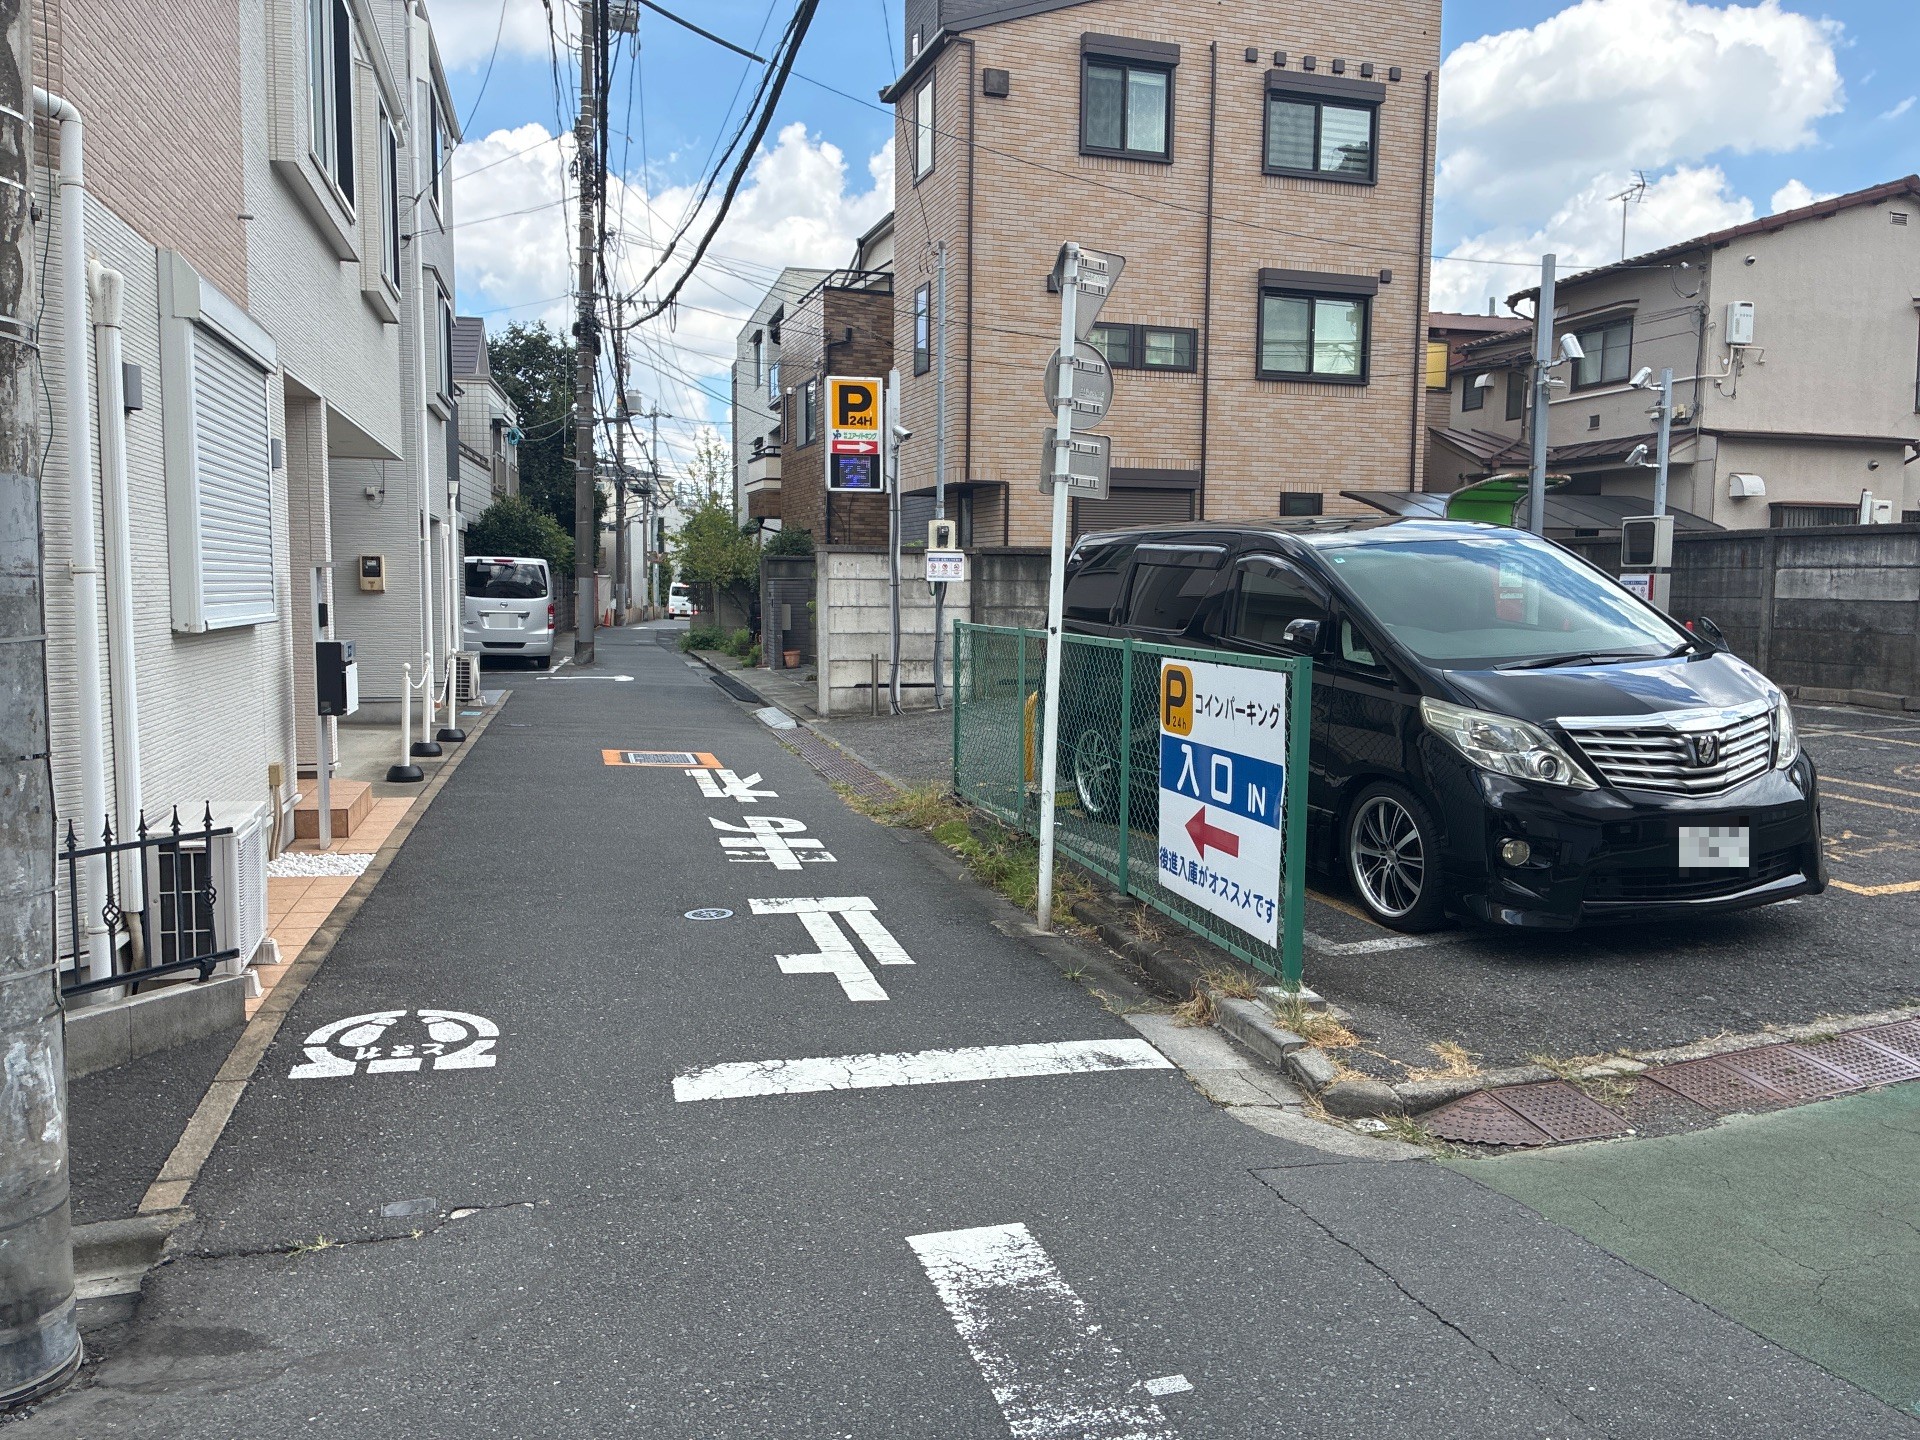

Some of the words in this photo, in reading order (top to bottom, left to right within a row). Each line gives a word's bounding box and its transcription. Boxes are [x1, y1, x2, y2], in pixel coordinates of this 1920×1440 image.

[839, 385, 872, 425] P
[849, 416, 872, 426] 24H
[1165, 670, 1187, 726] P
[1195, 693, 1281, 730] コインパーキング
[1172, 716, 1187, 730] 24h
[1176, 744, 1233, 804] 入口
[1247, 782, 1265, 817] IN
[684, 768, 916, 1002] 止まれ
[1159, 846, 1276, 924] 後進入庫がオススメです
[355, 1043, 444, 1060] とまれ
